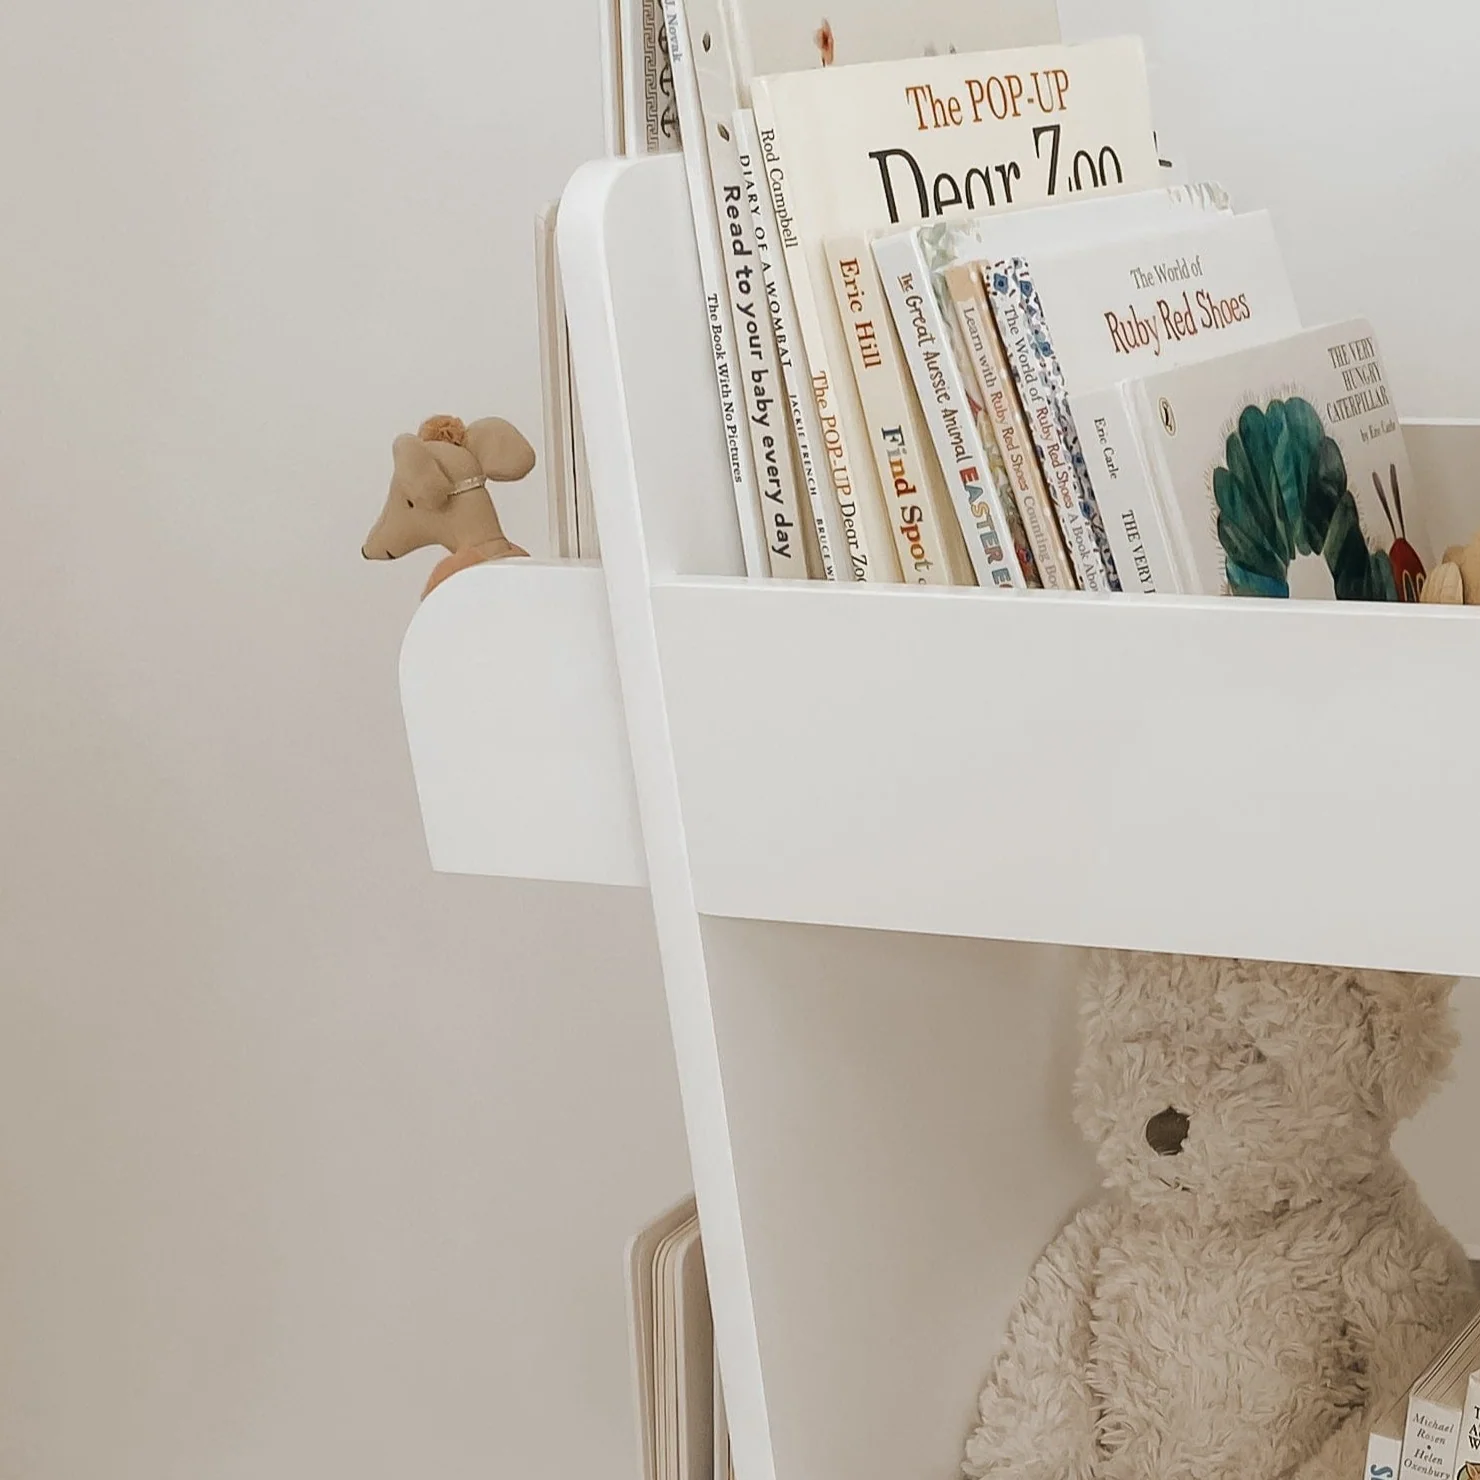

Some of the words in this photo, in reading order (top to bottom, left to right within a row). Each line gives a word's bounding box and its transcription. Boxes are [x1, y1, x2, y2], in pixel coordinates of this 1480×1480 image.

[667, 13, 683, 62] Novak
[905, 84, 963, 131] The
[965, 69, 1069, 123] POP-UP
[761, 128, 780, 163] Rod
[740, 155, 761, 216] DIARY
[868, 148, 1021, 224] Dear
[724, 185, 753, 256] Read
[770, 167, 798, 248] Campbell
[755, 226, 767, 251] OF
[736, 265, 753, 295] to
[761, 261, 772, 272] A
[897, 272, 914, 293] The
[1130, 267, 1154, 290] The
[1153, 257, 1190, 285] World
[1190, 254, 1204, 277] of
[708, 293, 720, 322] The
[766, 281, 792, 368] WOMBAT
[839, 258, 865, 313] Eric
[855, 320, 882, 369] Hill
[905, 295, 936, 348] Great
[1004, 304, 1020, 335] The
[1104, 304, 1161, 357] Ruby
[1156, 291, 1198, 341] Red
[1195, 289, 1250, 330] Shoes
[711, 324, 726, 360] Book
[737, 302, 763, 361] your
[1327, 344, 1350, 369] THE
[1348, 337, 1375, 362] VERY
[718, 363, 732, 399] With
[923, 351, 950, 404] Aussie
[1015, 336, 1037, 384] World
[1341, 361, 1382, 391] HUNGRY
[723, 401, 735, 421] No
[751, 369, 774, 428] baby
[1029, 387, 1044, 402] of
[1326, 385, 1389, 423] CATERPILLAR
[941, 407, 973, 464] Animal
[963, 306, 984, 352] Learn
[979, 354, 997, 389] with
[990, 391, 1008, 427] Ruby
[1002, 426, 1019, 452] Red
[1011, 454, 1028, 492] Shoes
[1023, 496, 1050, 562] Counting
[1036, 406, 1053, 442] Ruby
[727, 424, 742, 484] Pictures
[763, 435, 785, 506] every
[813, 371, 829, 409] The
[821, 414, 852, 496] POP-UP
[841, 502, 858, 549] Dear
[1047, 443, 1064, 469] Red
[790, 395, 805, 438] JACKIE
[801, 444, 817, 495] FRENCH
[816, 518, 831, 560] BRUCE
[881, 425, 917, 498] Find
[900, 505, 933, 572] Spot
[1056, 470, 1074, 510] Shoes
[959, 466, 1004, 565] EASTER
[1067, 512, 1080, 524] A
[1094, 418, 1108, 444] Eric
[1104, 447, 1119, 480] Carle
[1122, 508, 1140, 542] THE
[1133, 544, 1153, 585] VERY
[772, 512, 793, 559] day
[1072, 526, 1091, 561] Book
[1413, 1413, 1455, 1433] Michael
[1417, 1428, 1446, 1445] Rosen
[1404, 1458, 1450, 1480] Oxenbury
[1413, 1448, 1443, 1466] Helen
